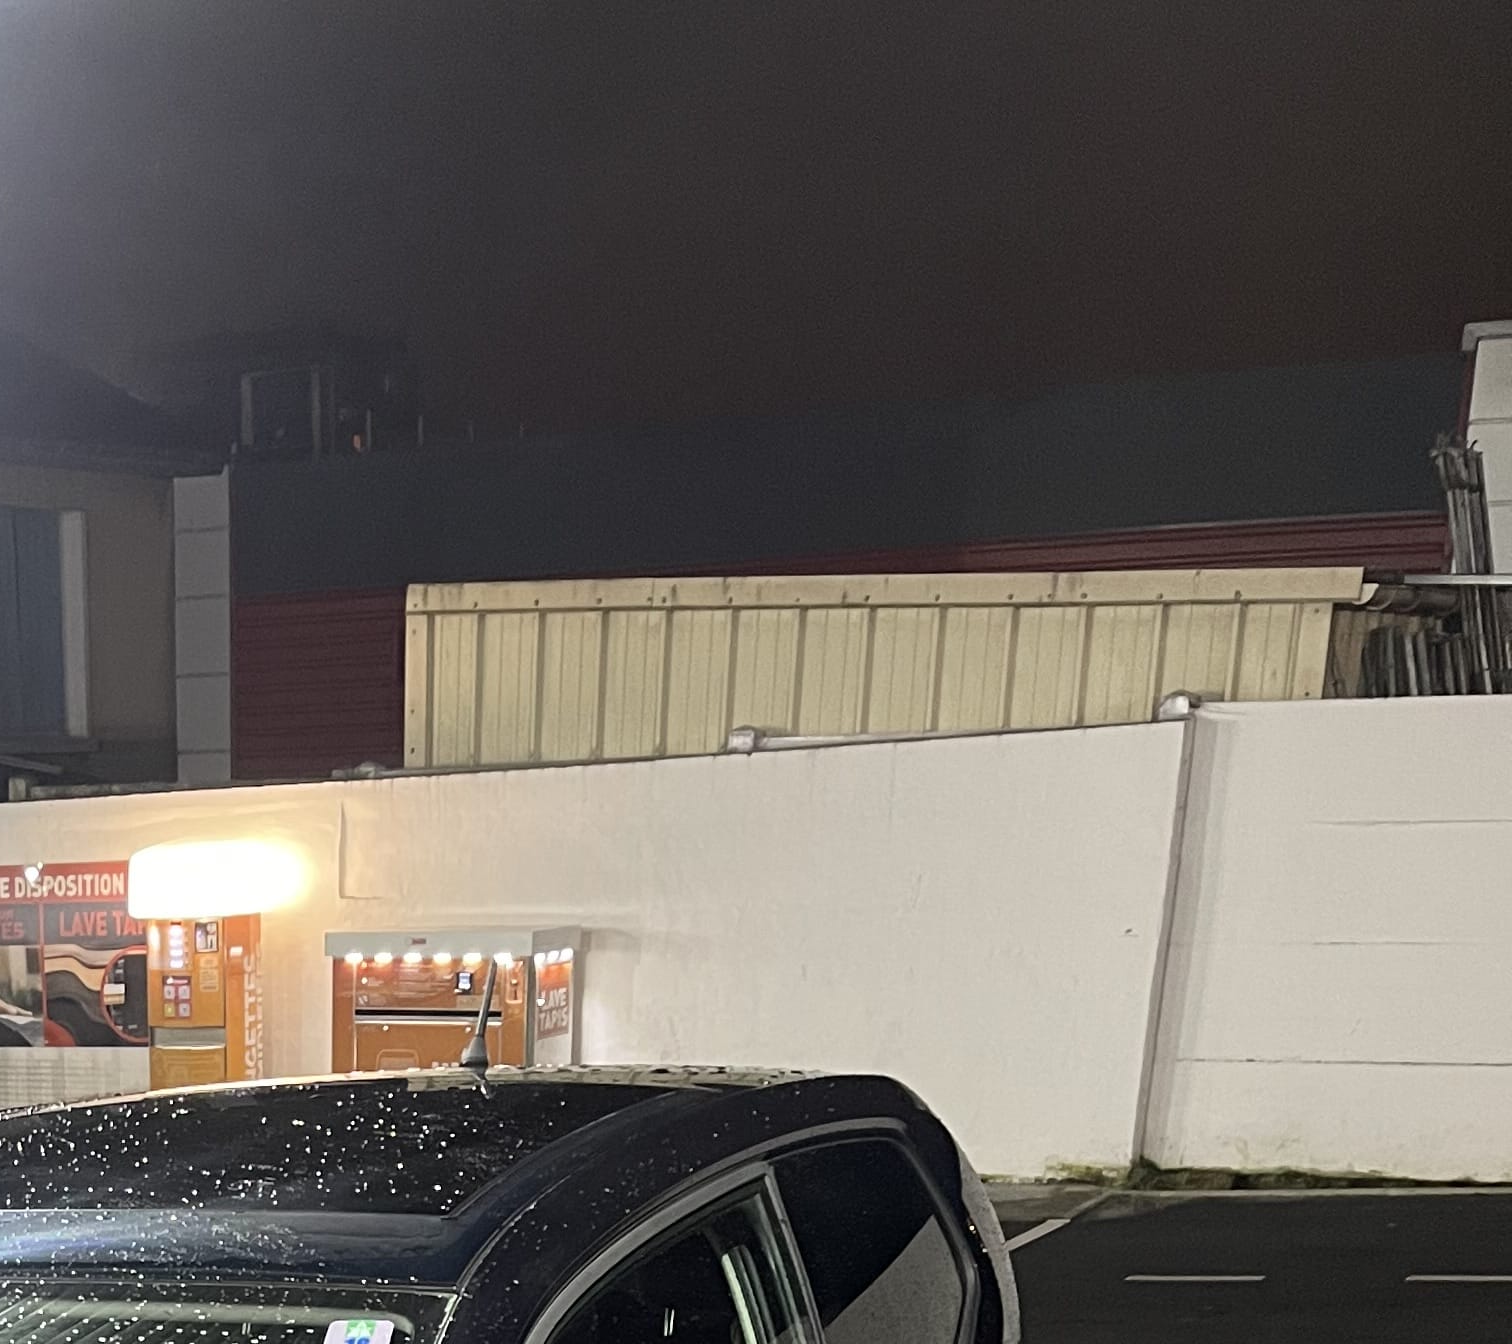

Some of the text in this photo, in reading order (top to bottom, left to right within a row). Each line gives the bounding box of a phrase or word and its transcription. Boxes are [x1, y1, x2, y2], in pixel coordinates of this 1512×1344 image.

[15, 873, 125, 899] DISPOSITION
[59, 911, 108, 937] LAVE
[540, 988, 568, 1009] LAVE
[539, 1007, 568, 1032] TAPIS
